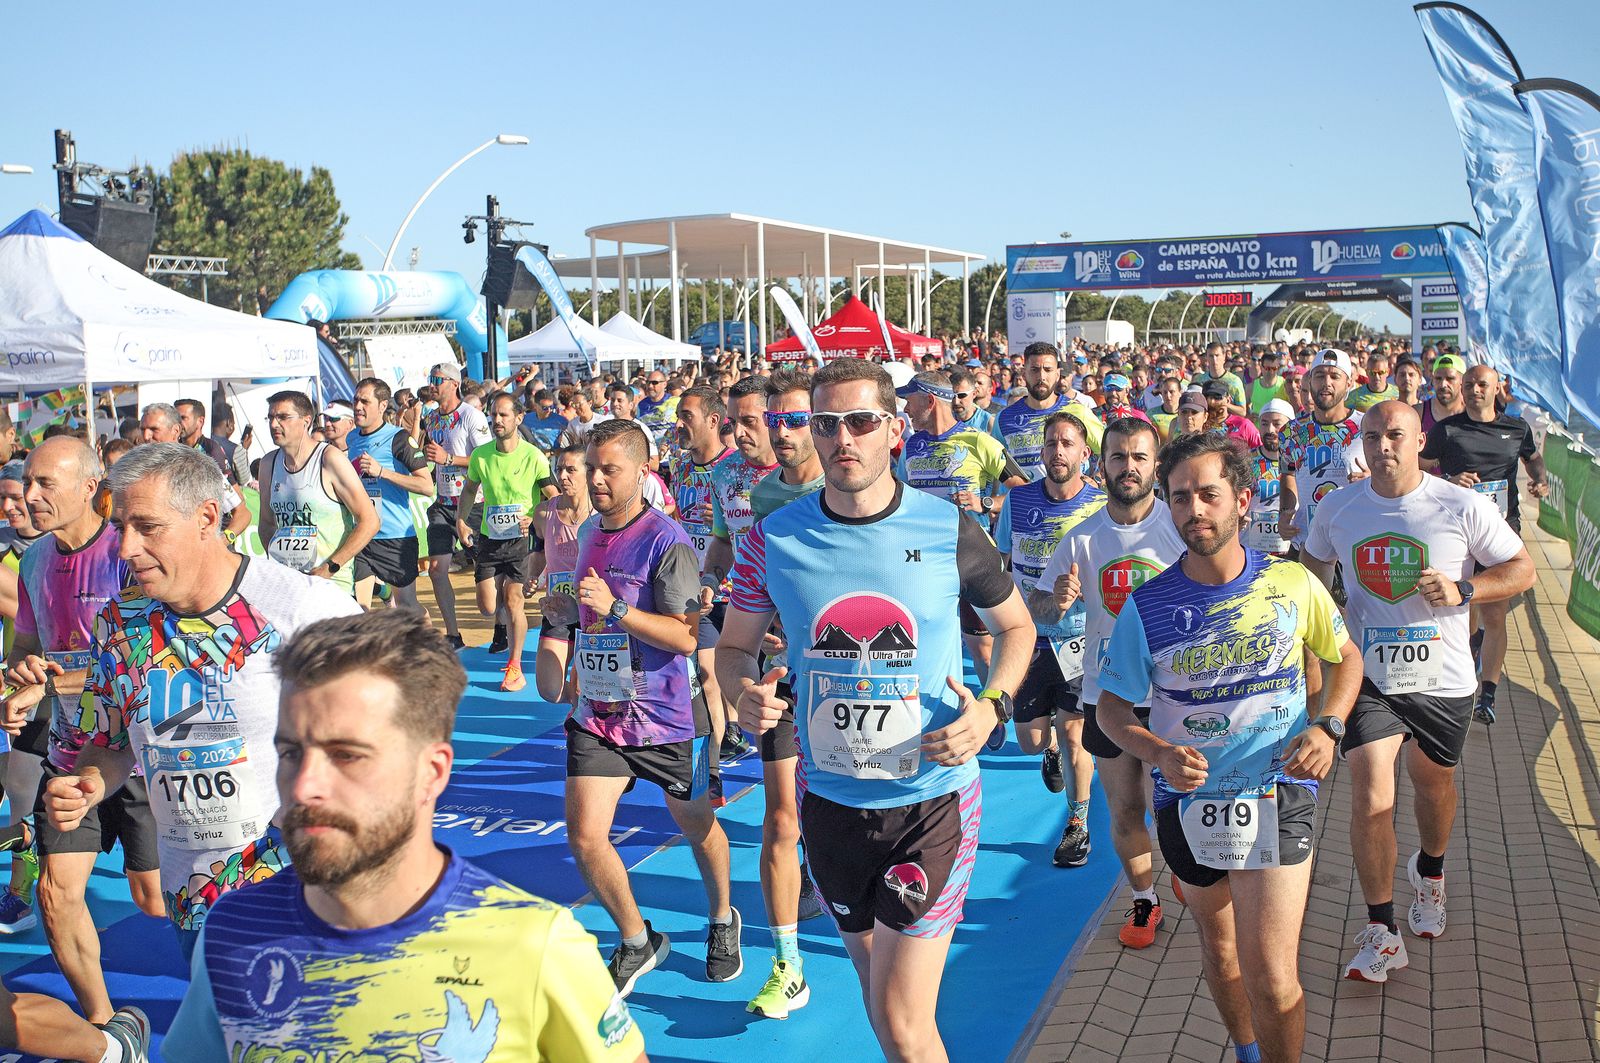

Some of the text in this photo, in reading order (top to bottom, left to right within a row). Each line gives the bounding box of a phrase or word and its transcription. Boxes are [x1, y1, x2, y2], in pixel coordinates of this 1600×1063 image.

[1159, 240, 1261, 257] CAMPEONATO
[1338, 244, 1381, 258] HUELVA
[1158, 252, 1298, 272] de ESPAÑA 10 km
[1207, 271, 1224, 280] ruta
[1225, 270, 1260, 279] Absoluto
[1269, 269, 1297, 277] Master
[7, 347, 55, 368] paim
[491, 514, 516, 525] 1531
[276, 538, 309, 551] 1722
[1363, 546, 1419, 565] TPL
[1413, 629, 1435, 639] 2023
[601, 638, 622, 648] 2023
[824, 650, 914, 660] CLUB Ultra Trail
[1172, 634, 1274, 676] HERMES
[1374, 644, 1430, 663] 1700
[579, 651, 619, 672] 1575
[886, 660, 912, 668] HUELVA
[831, 683, 854, 692] HUELVA
[879, 683, 909, 696] 2023
[1191, 678, 1291, 699] PALOS DE LA FRONTERA
[206, 703, 238, 720] VA
[833, 703, 892, 732] 977
[201, 747, 236, 764] 2023
[834, 746, 892, 755] GALVEZ RAPOSO
[853, 760, 882, 770] Syrluz
[159, 771, 236, 802] 1706
[437, 804, 514, 815] original
[1201, 803, 1251, 827] 819
[194, 830, 223, 840] Syrluz
[1218, 853, 1245, 861] Syrluz
[434, 976, 484, 987] SPALL
